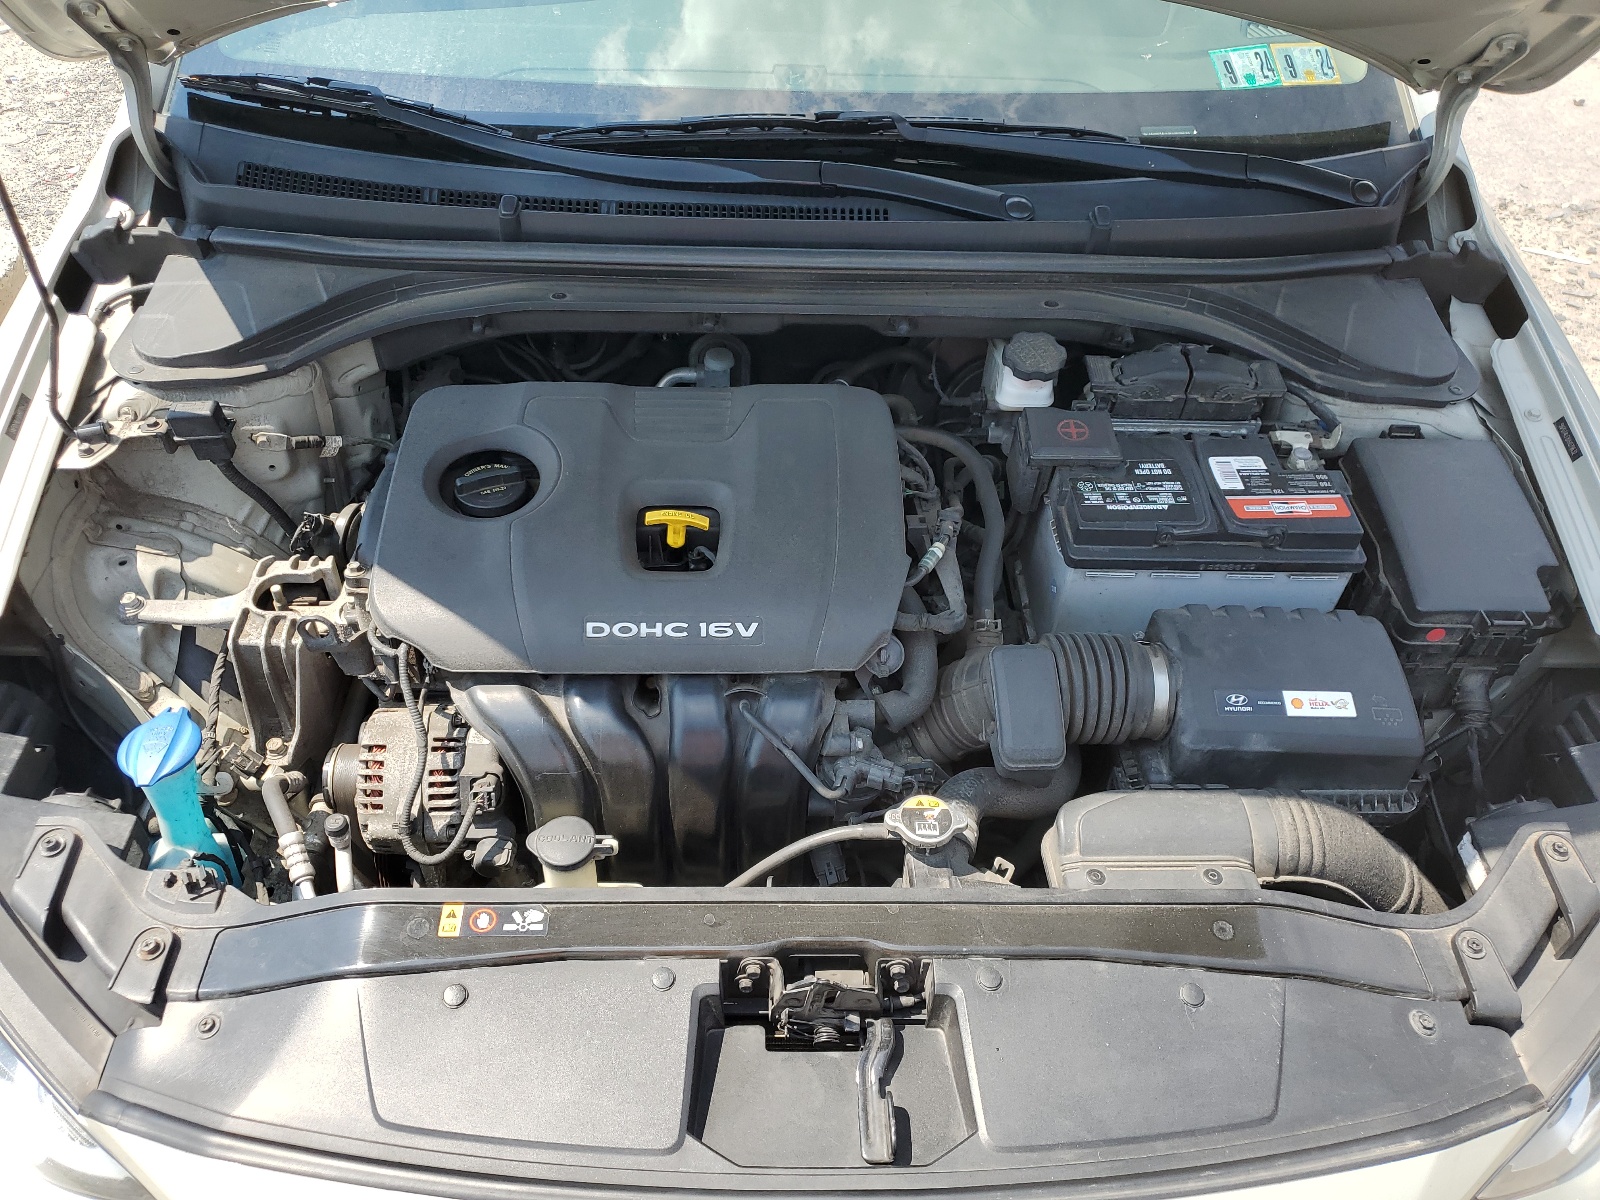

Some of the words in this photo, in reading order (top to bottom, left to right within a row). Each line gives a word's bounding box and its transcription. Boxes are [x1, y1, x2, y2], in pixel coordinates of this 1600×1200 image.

[1222, 59, 1238, 85] 9
[1253, 50, 1277, 79] 24
[1283, 54, 1298, 79] 9
[1315, 48, 1336, 79] 24
[1272, 503, 1307, 511] CHAMPION
[586, 622, 689, 638] DOHC
[699, 622, 759, 638] 16V
[538, 833, 595, 844] COOLANT
